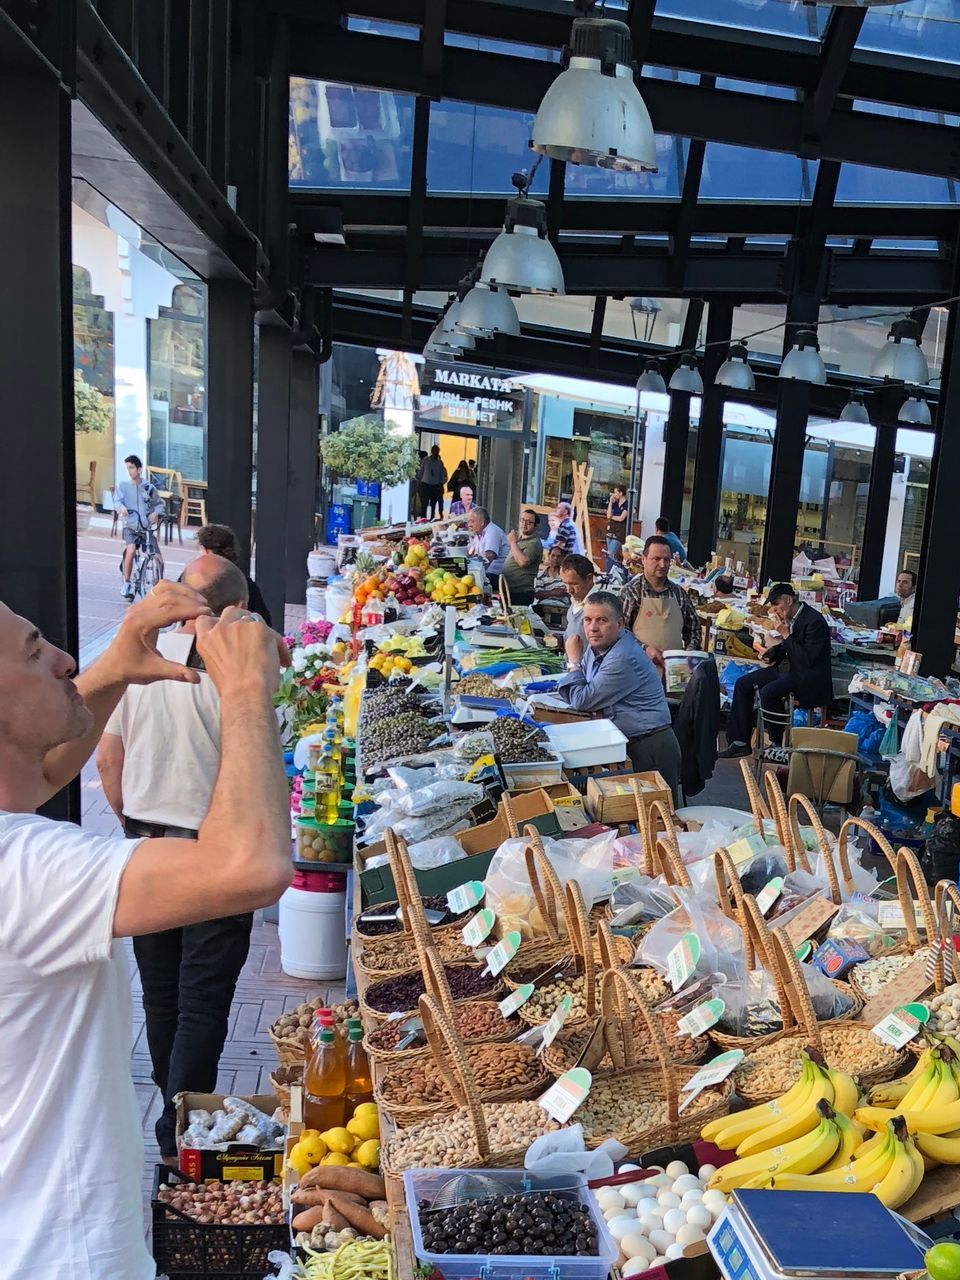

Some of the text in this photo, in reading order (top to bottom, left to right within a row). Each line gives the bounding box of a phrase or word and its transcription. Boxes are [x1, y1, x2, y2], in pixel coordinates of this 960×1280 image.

[434, 369, 511, 393] MARKATA
[430, 390, 513, 412] MISH PESHK
